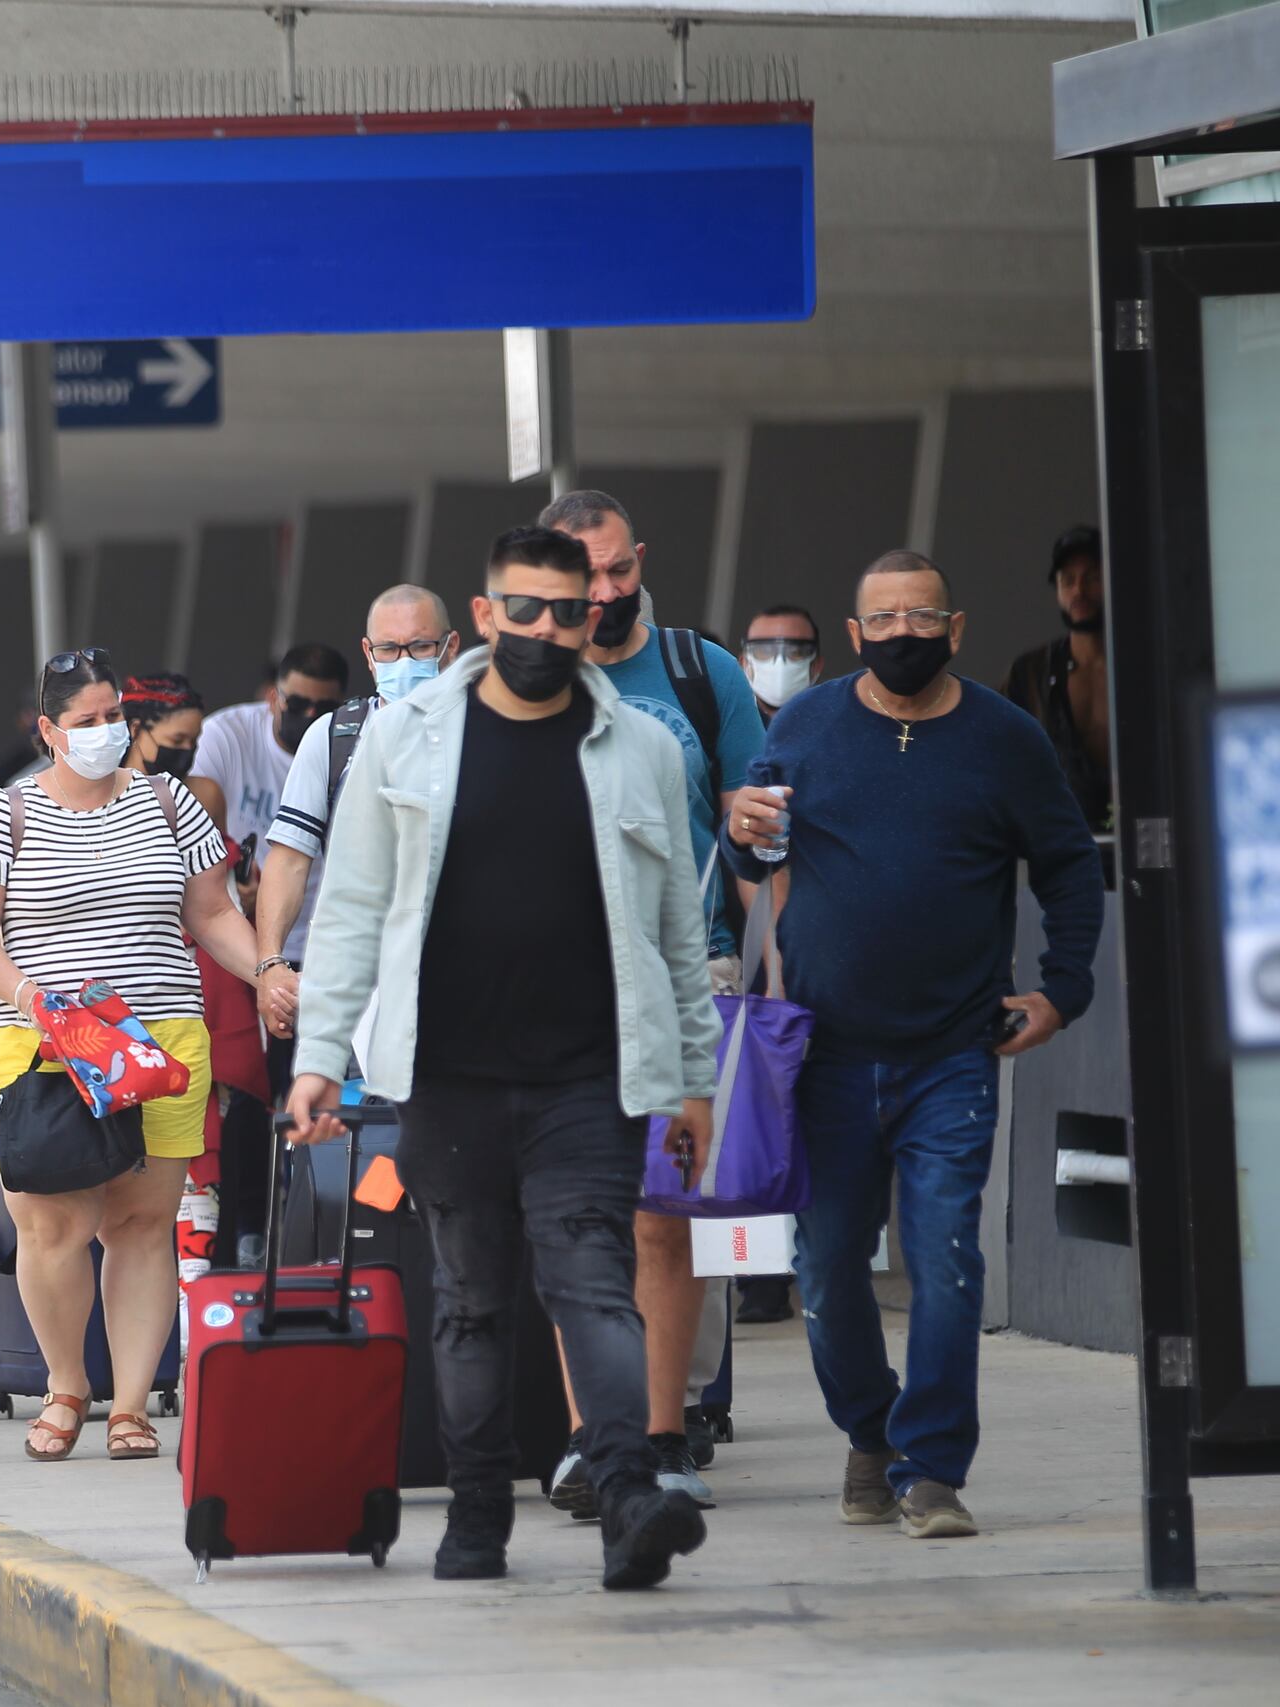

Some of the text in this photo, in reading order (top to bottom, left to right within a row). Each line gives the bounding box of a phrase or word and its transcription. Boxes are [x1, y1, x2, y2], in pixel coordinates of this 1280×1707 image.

[56, 347, 105, 373] ator
[51, 378, 132, 405] ensor
[240, 784, 275, 822] HU
[734, 1225, 748, 1261] BAGGAGE
